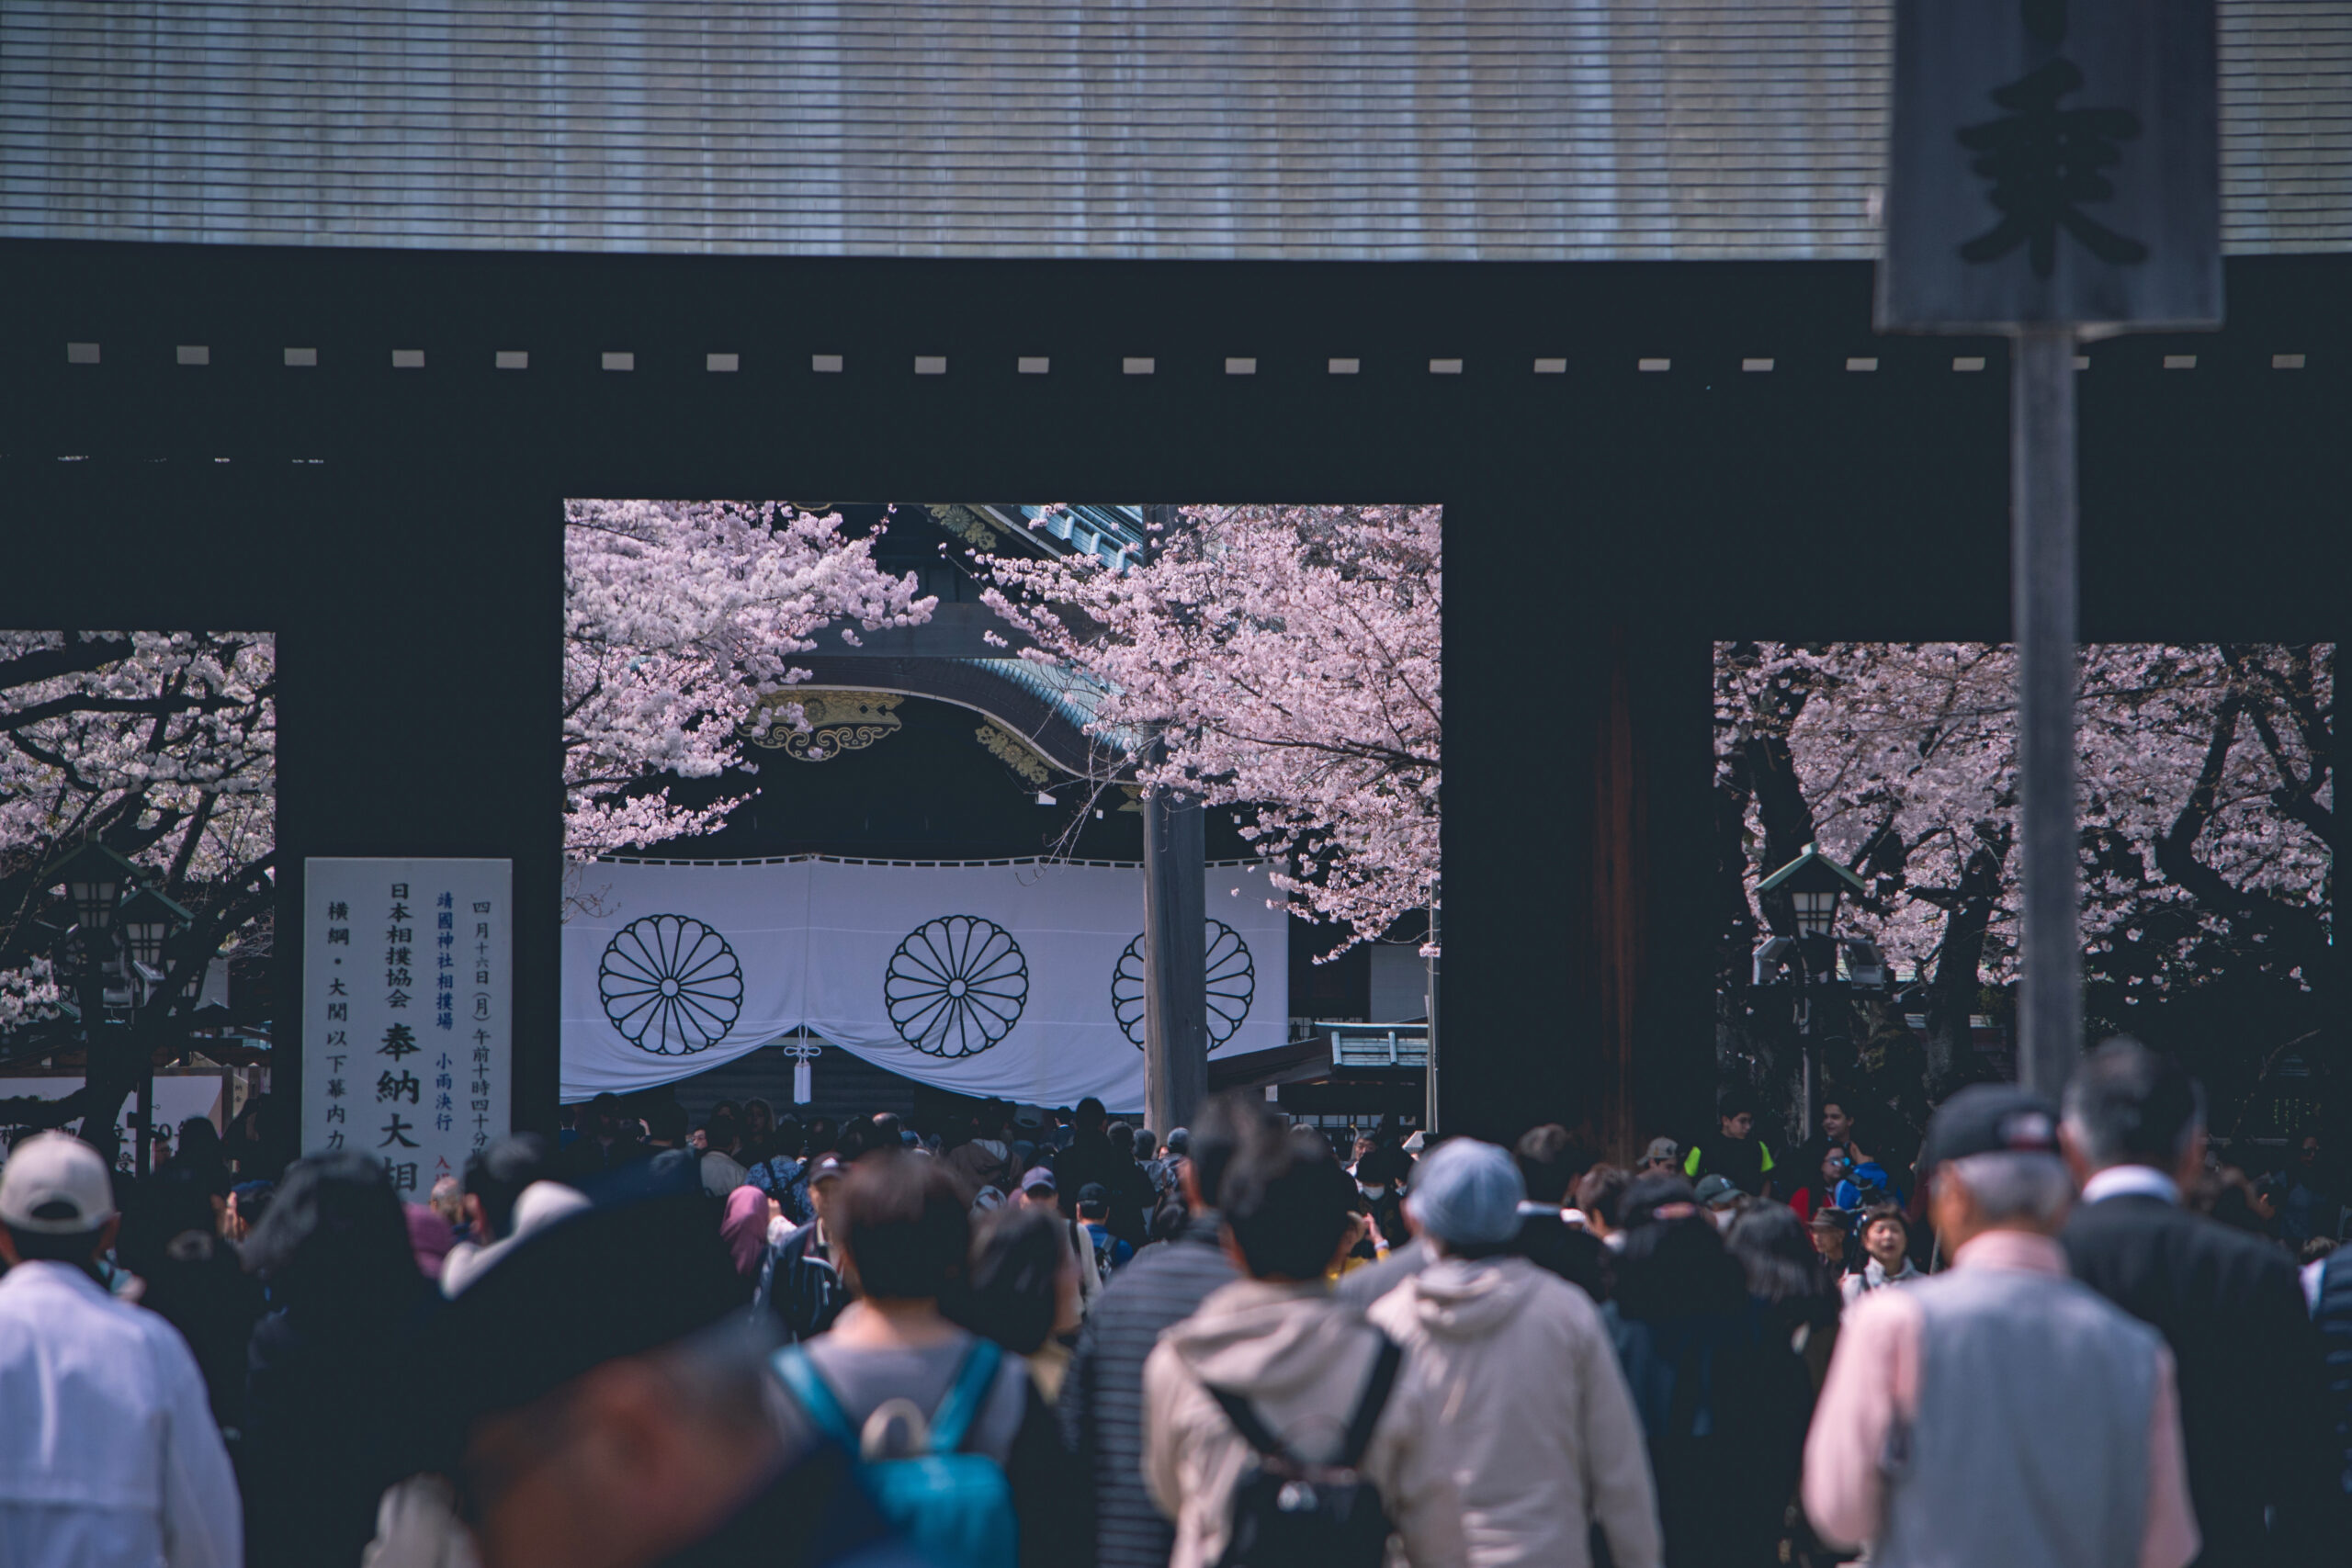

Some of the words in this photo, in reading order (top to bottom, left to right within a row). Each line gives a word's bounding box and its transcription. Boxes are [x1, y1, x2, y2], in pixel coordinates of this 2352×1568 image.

[1957, 0, 2148, 280] 乗
[384, 882, 413, 1010] 日本相撲協会
[436, 891, 455, 1031] 靖國神社相撲場
[435, 1052, 454, 1133] 小雨決行
[470, 901, 492, 1162] 四月十六日（月）午前十時四十分
